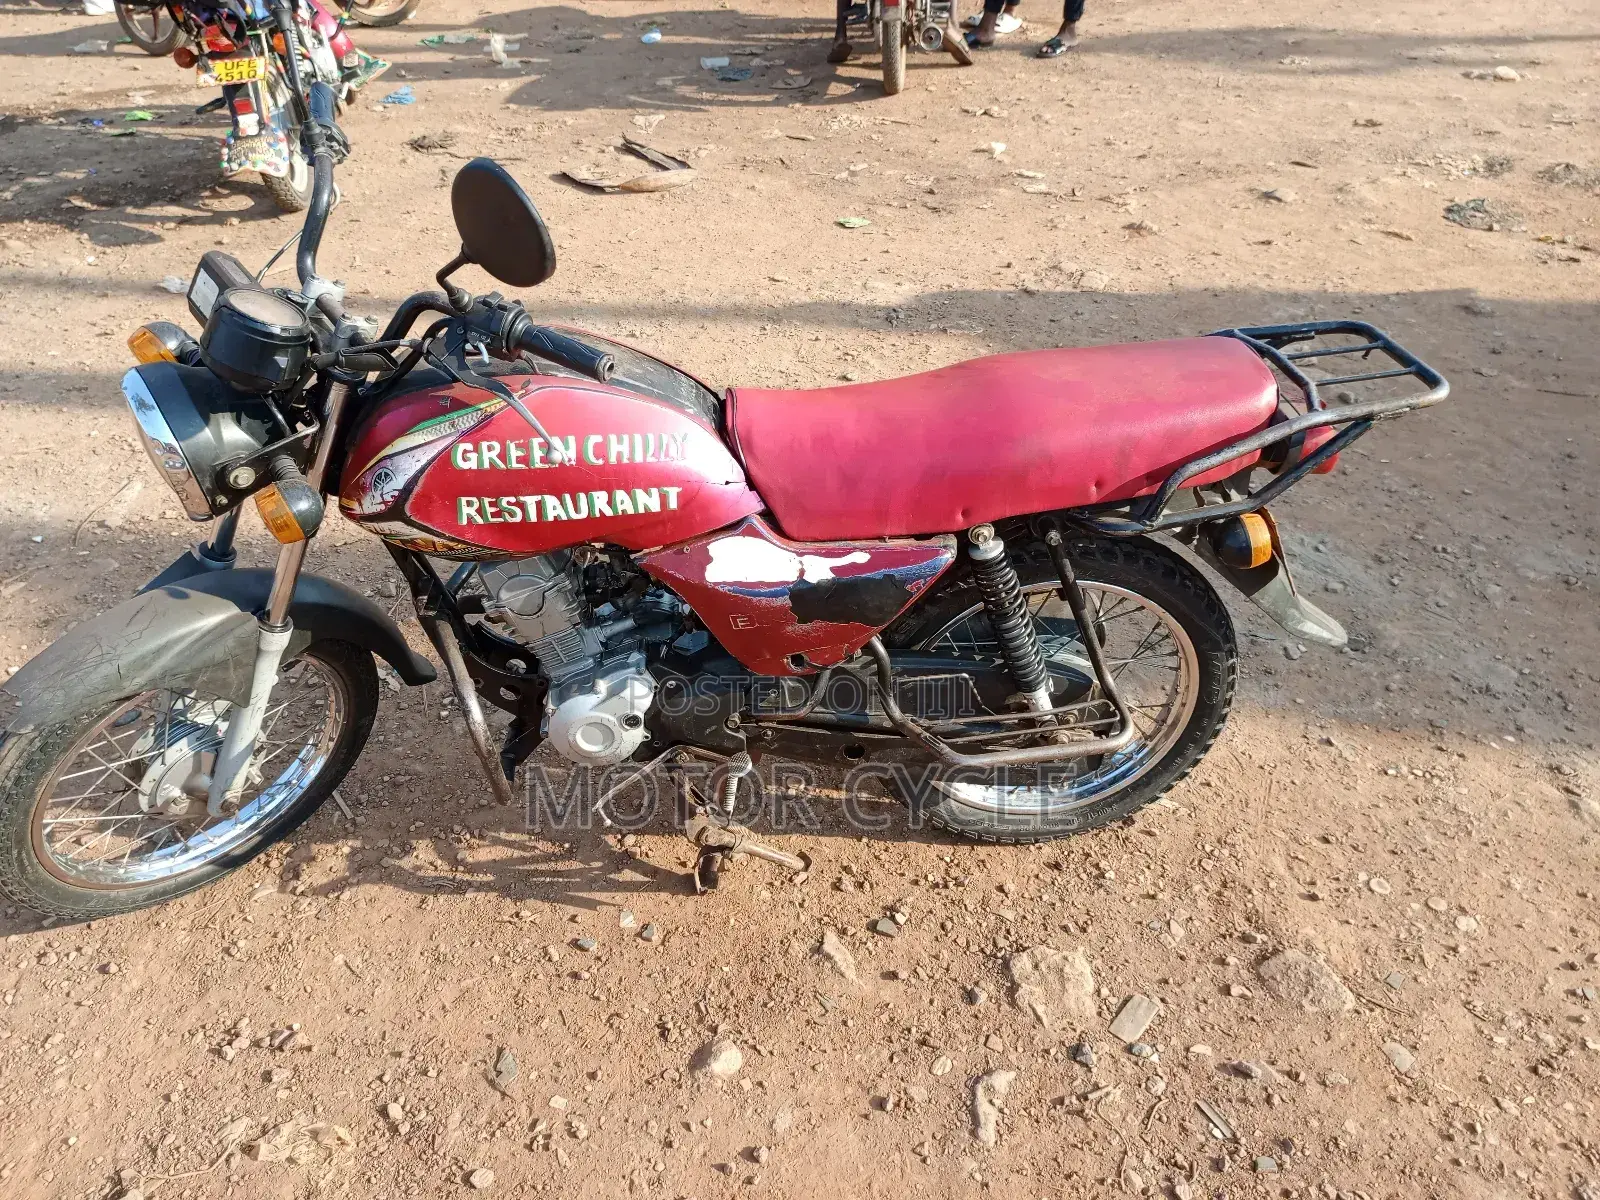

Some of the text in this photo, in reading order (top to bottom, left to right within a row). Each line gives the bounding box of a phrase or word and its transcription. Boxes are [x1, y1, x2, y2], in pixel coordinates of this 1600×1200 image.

[224, 59, 257, 71] UFE
[452, 432, 690, 470] GREEN CHILLY
[456, 486, 683, 526] RESTAURANT
